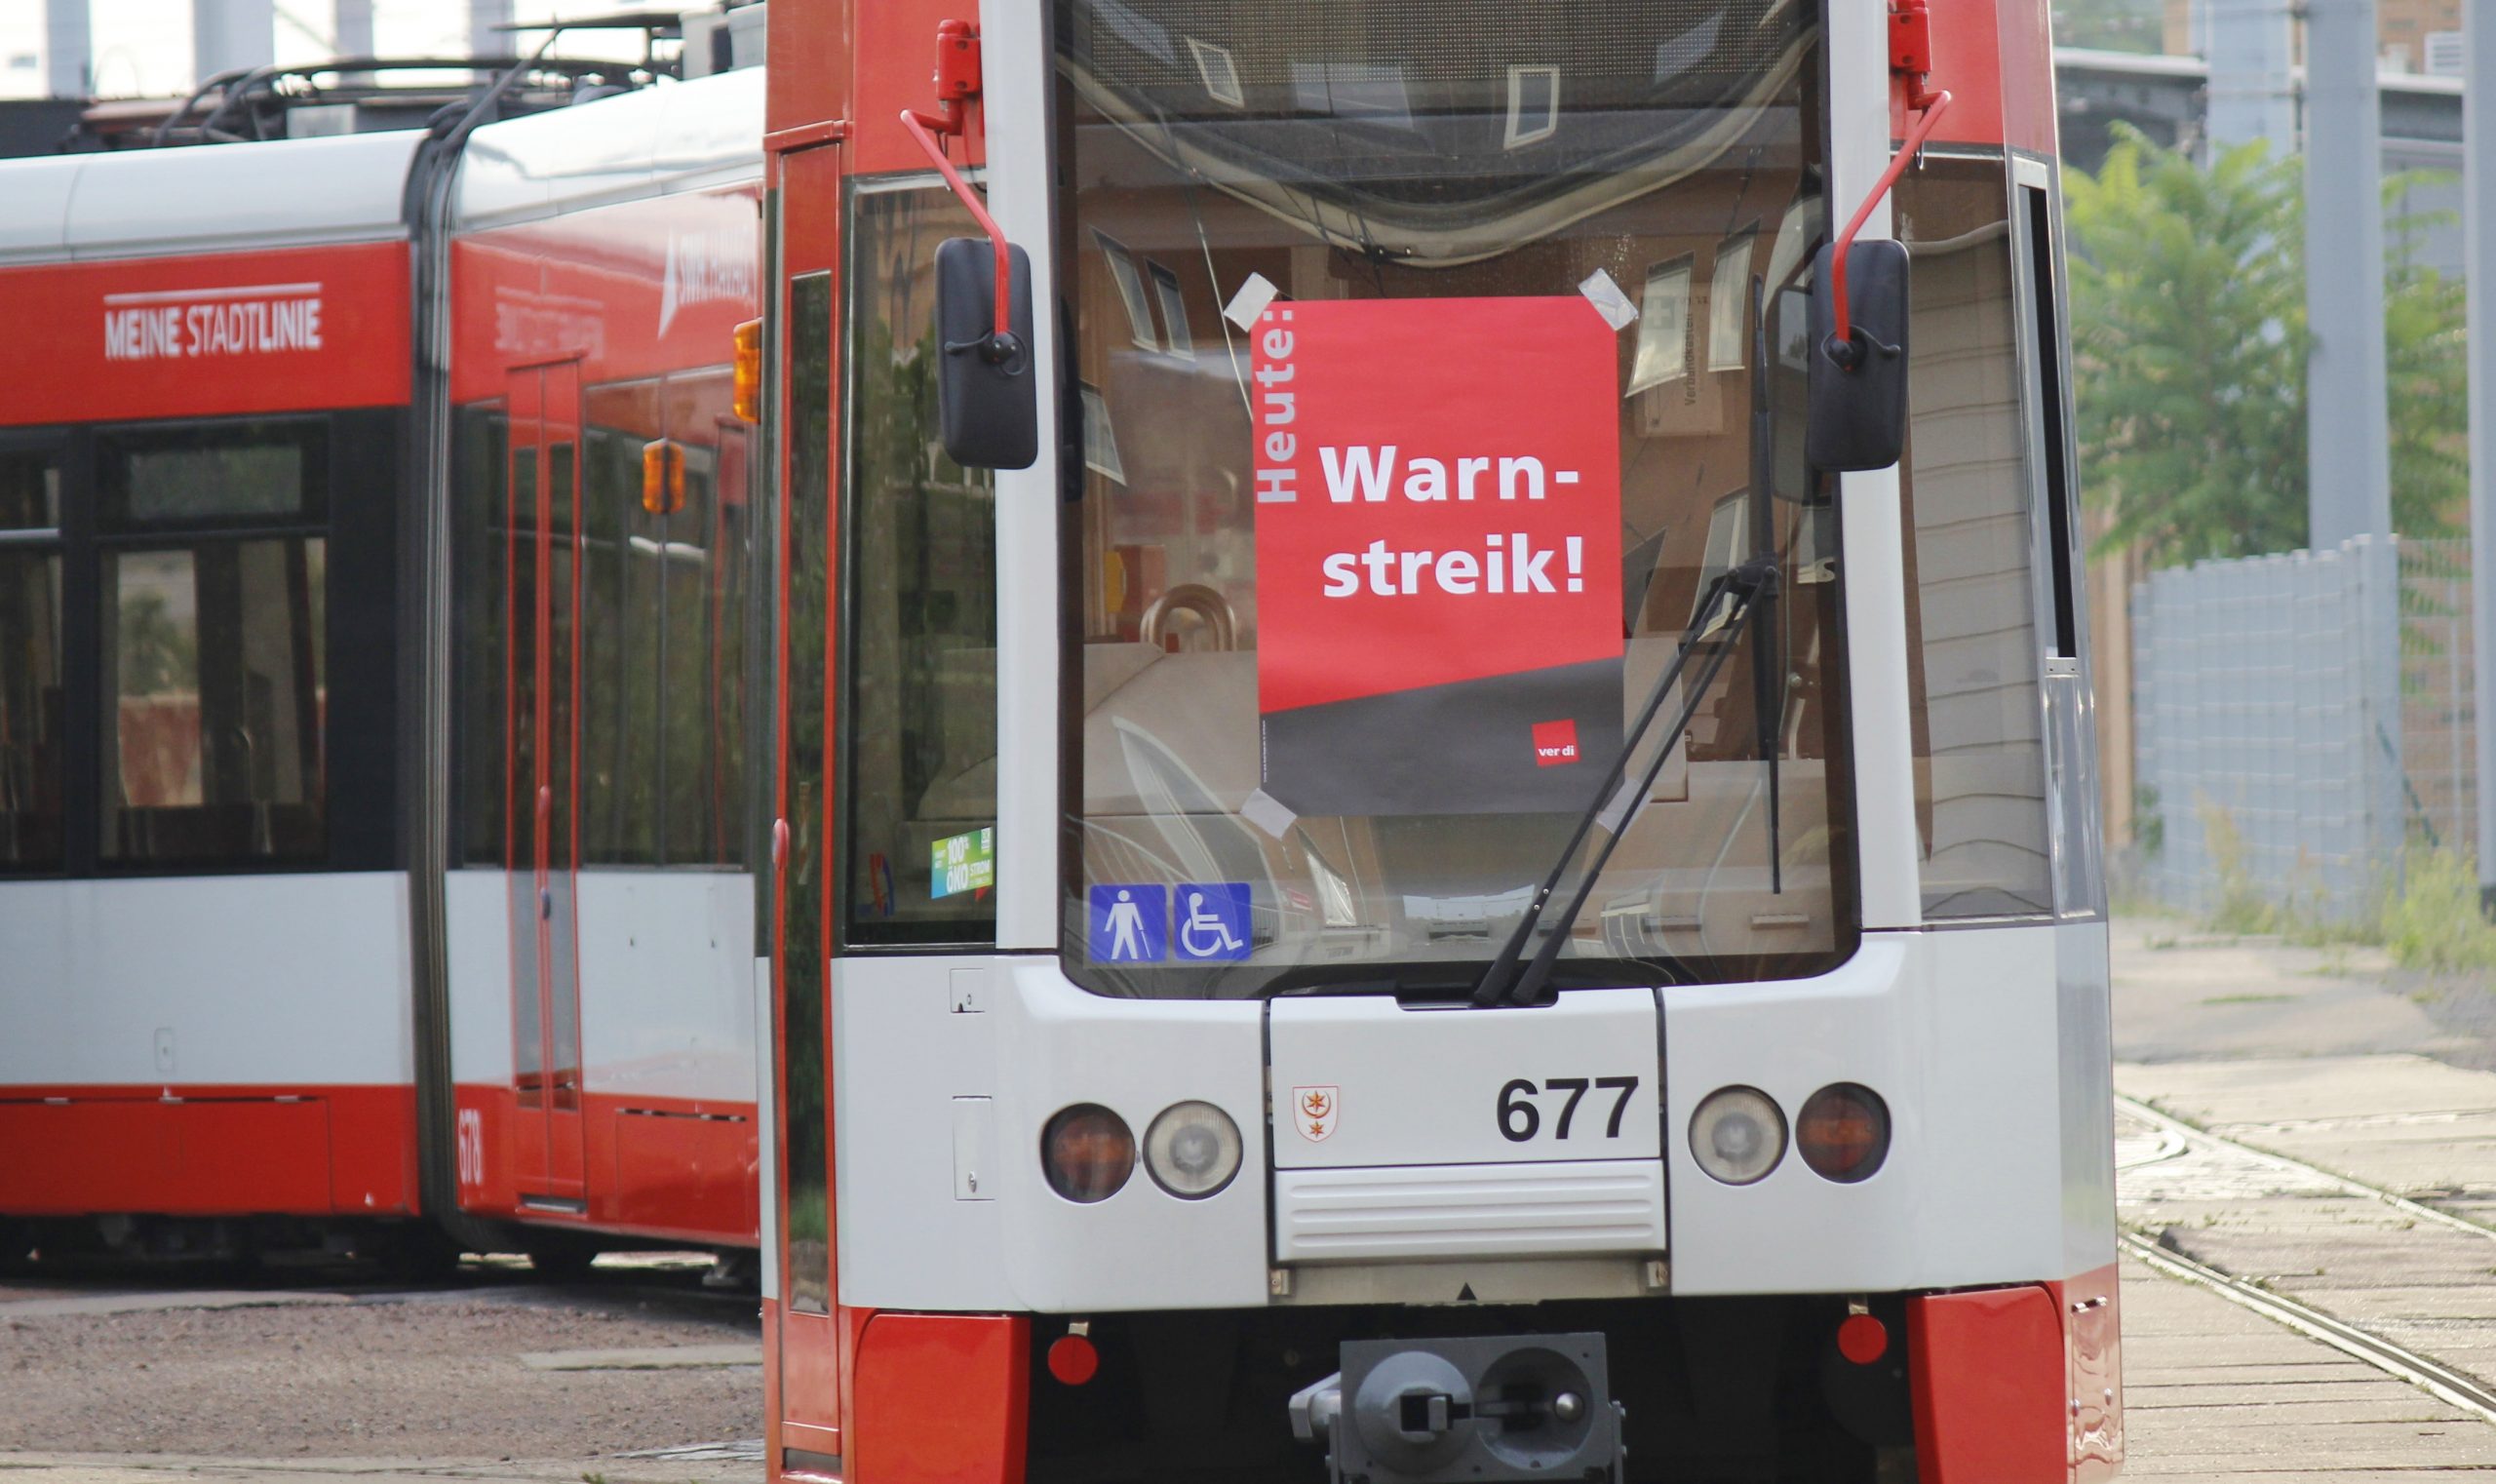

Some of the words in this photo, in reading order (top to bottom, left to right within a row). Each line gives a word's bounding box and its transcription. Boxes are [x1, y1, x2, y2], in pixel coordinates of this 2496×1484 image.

[105, 305, 181, 361] MEINE
[186, 298, 323, 357] STADTLINIE
[1255, 309, 1297, 503] Heute:
[1318, 445, 1579, 503] Warn-
[1322, 532, 1583, 598] streik!
[946, 863, 968, 893] ÖKO
[1497, 1075, 1639, 1143] 677
[458, 1109, 482, 1186] 678
